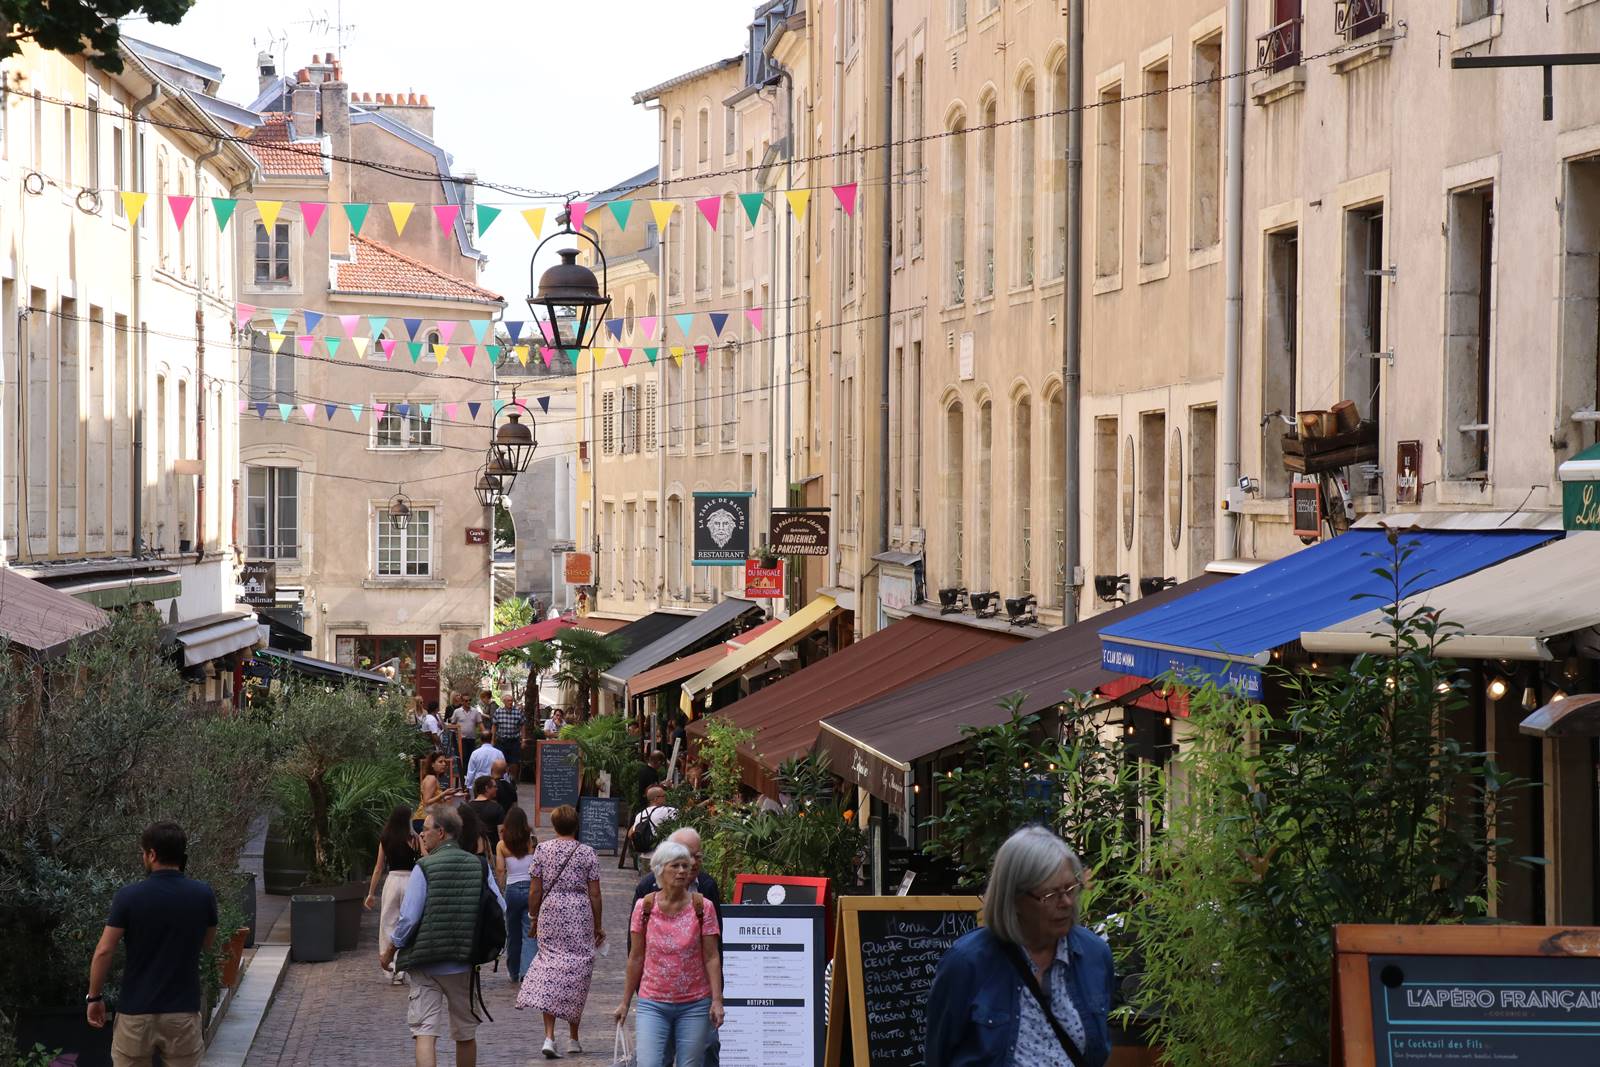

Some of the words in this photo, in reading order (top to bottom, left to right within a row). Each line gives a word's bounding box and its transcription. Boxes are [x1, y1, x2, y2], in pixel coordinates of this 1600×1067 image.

[699, 499, 716, 517] TABLE
[729, 501, 745, 530] BACCHUS
[782, 534, 817, 544] INDIENNES
[777, 545, 828, 555] PAKISTANAISES
[756, 569, 781, 577] BENGALE
[739, 926, 782, 936] MARCELLA
[862, 940, 903, 957] QUICHE
[908, 939, 952, 950] LORRAIN
[1407, 987, 1495, 1009] L'APÉRO
[868, 1011, 906, 1024] POISSON
[1394, 1039, 1404, 1048] Le
[1407, 1039, 1444, 1049] Cocktail
[1448, 1039, 1463, 1049] des
[1466, 1039, 1482, 1049] Fils
